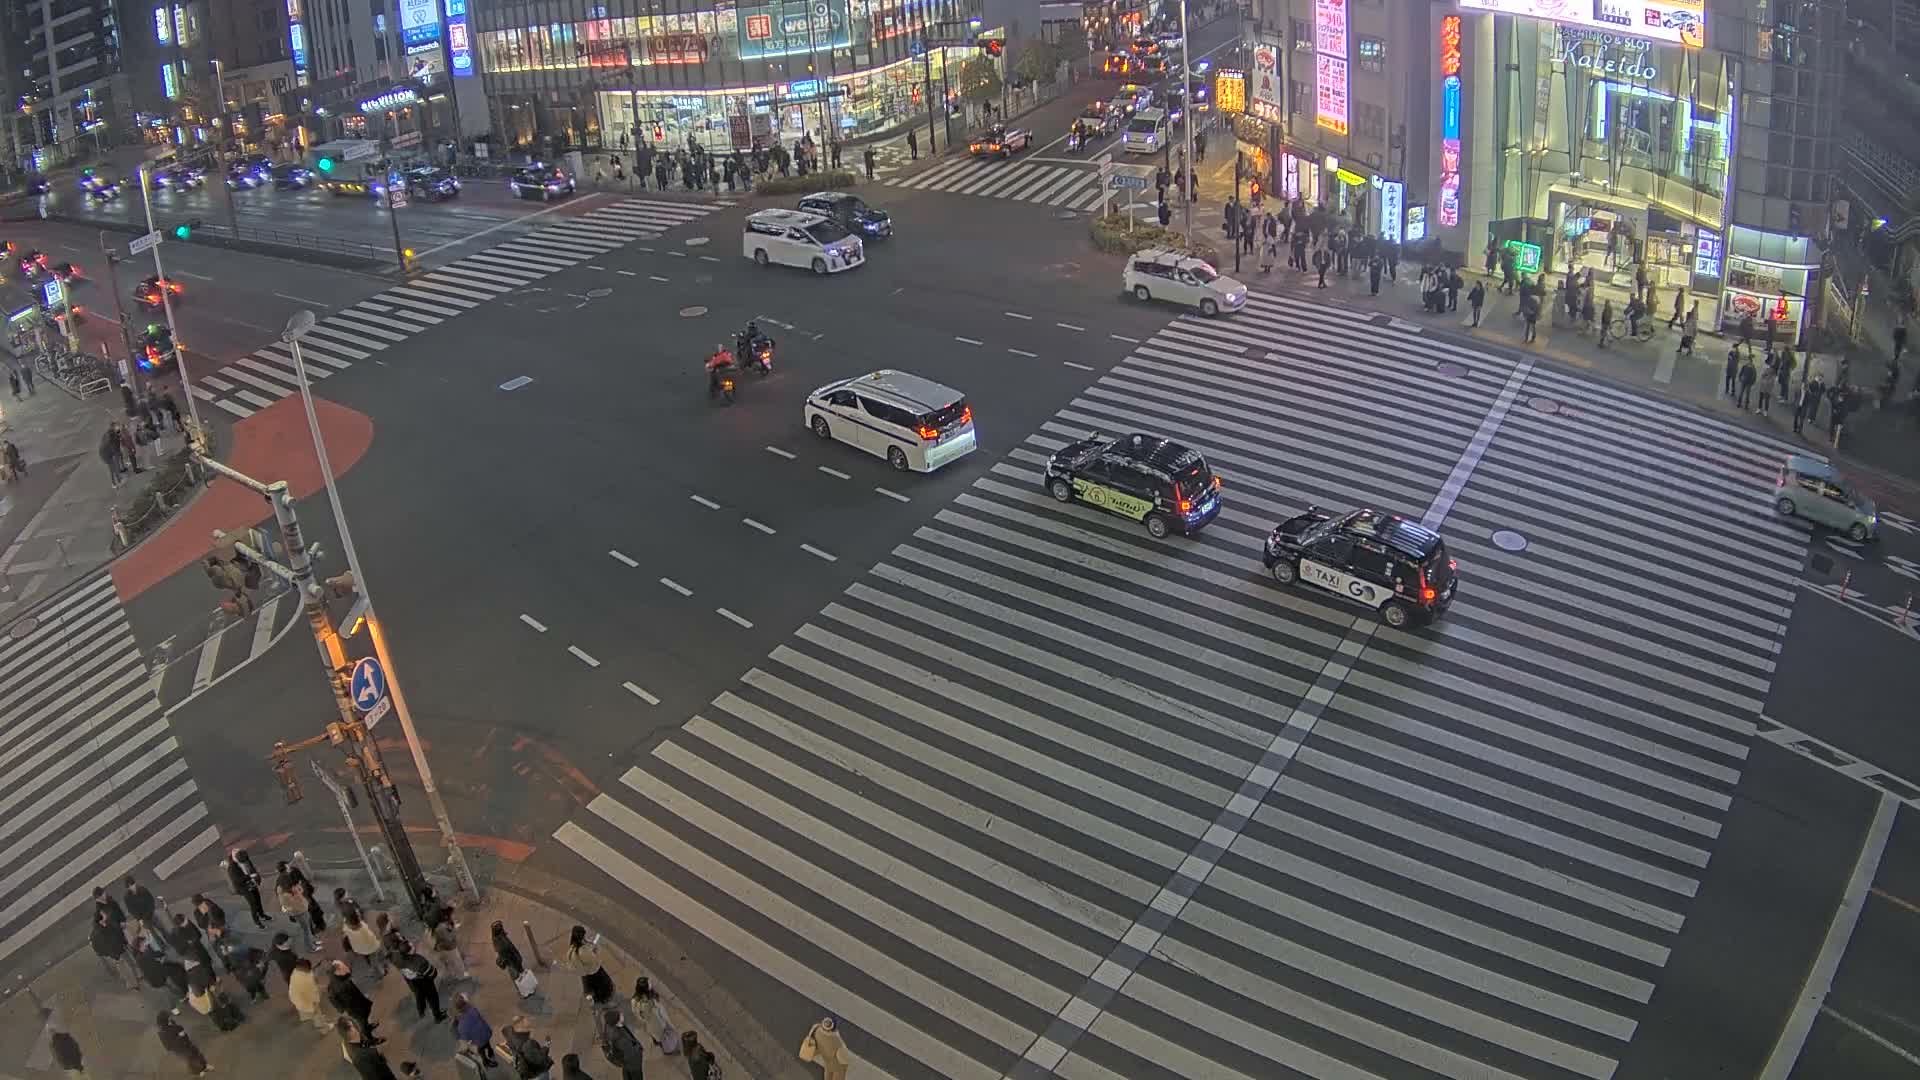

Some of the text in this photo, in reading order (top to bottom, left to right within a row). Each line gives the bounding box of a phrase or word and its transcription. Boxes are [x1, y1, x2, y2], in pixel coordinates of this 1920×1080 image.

[1625, 37, 1653, 52] SLOT
[1562, 38, 1657, 80] Kaleido
[1316, 569, 1340, 585] TAXI
